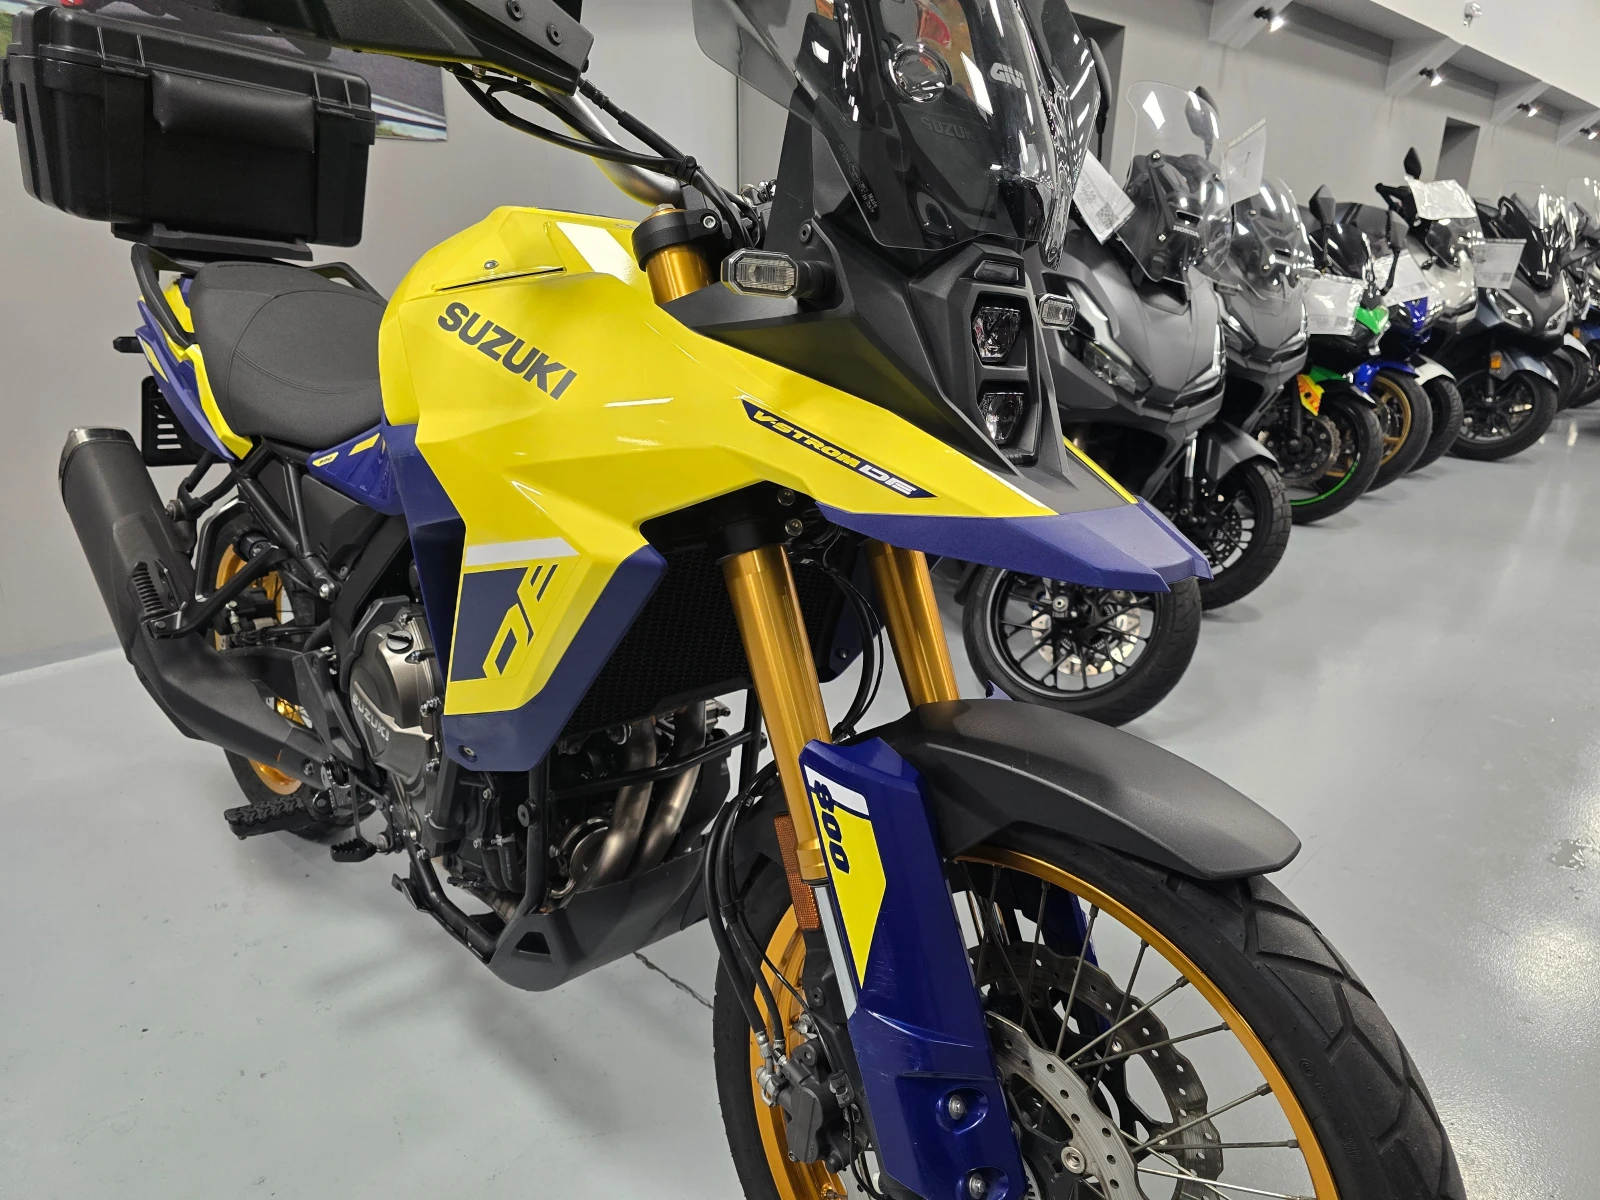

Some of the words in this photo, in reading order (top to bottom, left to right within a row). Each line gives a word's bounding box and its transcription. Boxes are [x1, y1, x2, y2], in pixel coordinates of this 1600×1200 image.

[990, 62, 1028, 92] GIVI
[919, 117, 978, 142] SUZUK
[1172, 224, 1200, 238] HONDA
[437, 301, 578, 401] SUZUKI
[753, 410, 861, 468] V-STROM
[858, 464, 918, 496] DE
[352, 693, 390, 742] SUZUKI
[813, 779, 850, 875] 800
